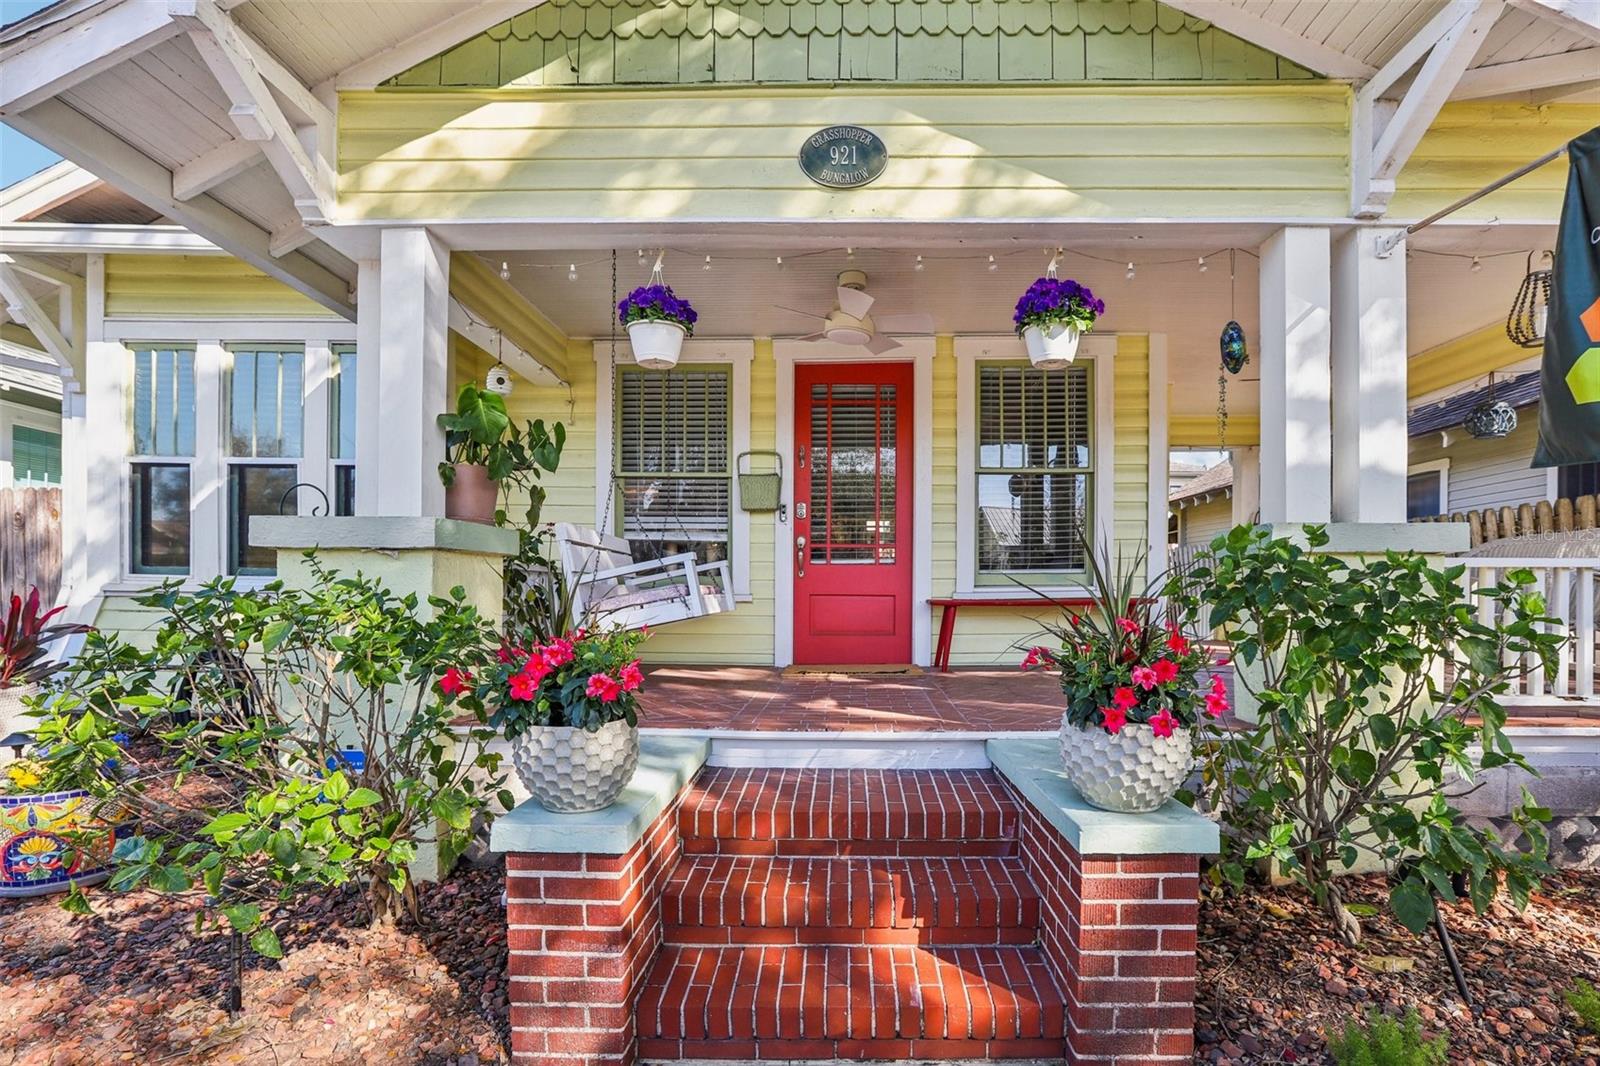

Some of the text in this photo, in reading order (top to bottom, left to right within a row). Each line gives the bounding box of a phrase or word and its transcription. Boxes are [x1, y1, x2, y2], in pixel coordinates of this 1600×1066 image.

[810, 128, 873, 148] GRASSHOPPER
[830, 145, 857, 165] 921
[819, 167, 869, 183] BUNGALOW
